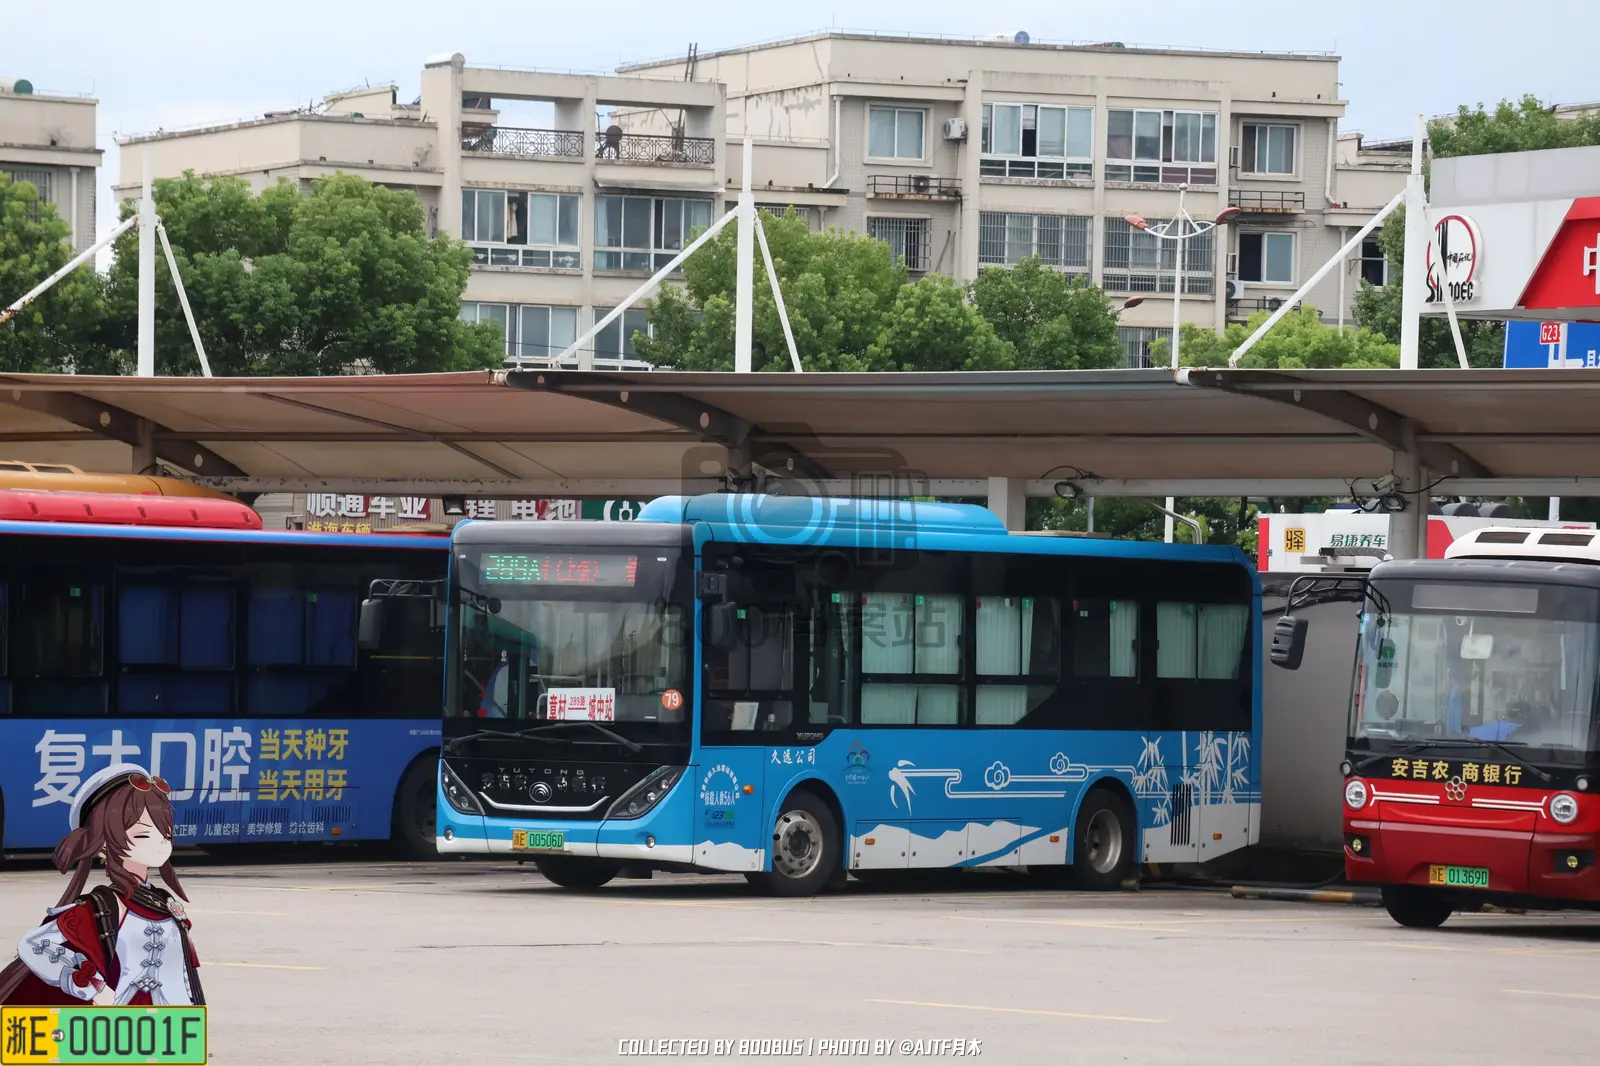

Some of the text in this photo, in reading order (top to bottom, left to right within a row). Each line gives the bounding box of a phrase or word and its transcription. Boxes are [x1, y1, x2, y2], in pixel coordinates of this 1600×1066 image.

[1542, 324, 1561, 341] G23
[307, 493, 428, 519] 顺通车业
[1330, 534, 1386, 547] 易捷养车
[665, 693, 679, 706] 79
[259, 729, 349, 761] 当天种牙
[499, 767, 585, 776] YUTONG
[258, 769, 348, 802] 当天用牙
[203, 823, 240, 836] 儿童齿科
[247, 821, 282, 835] 美学修复
